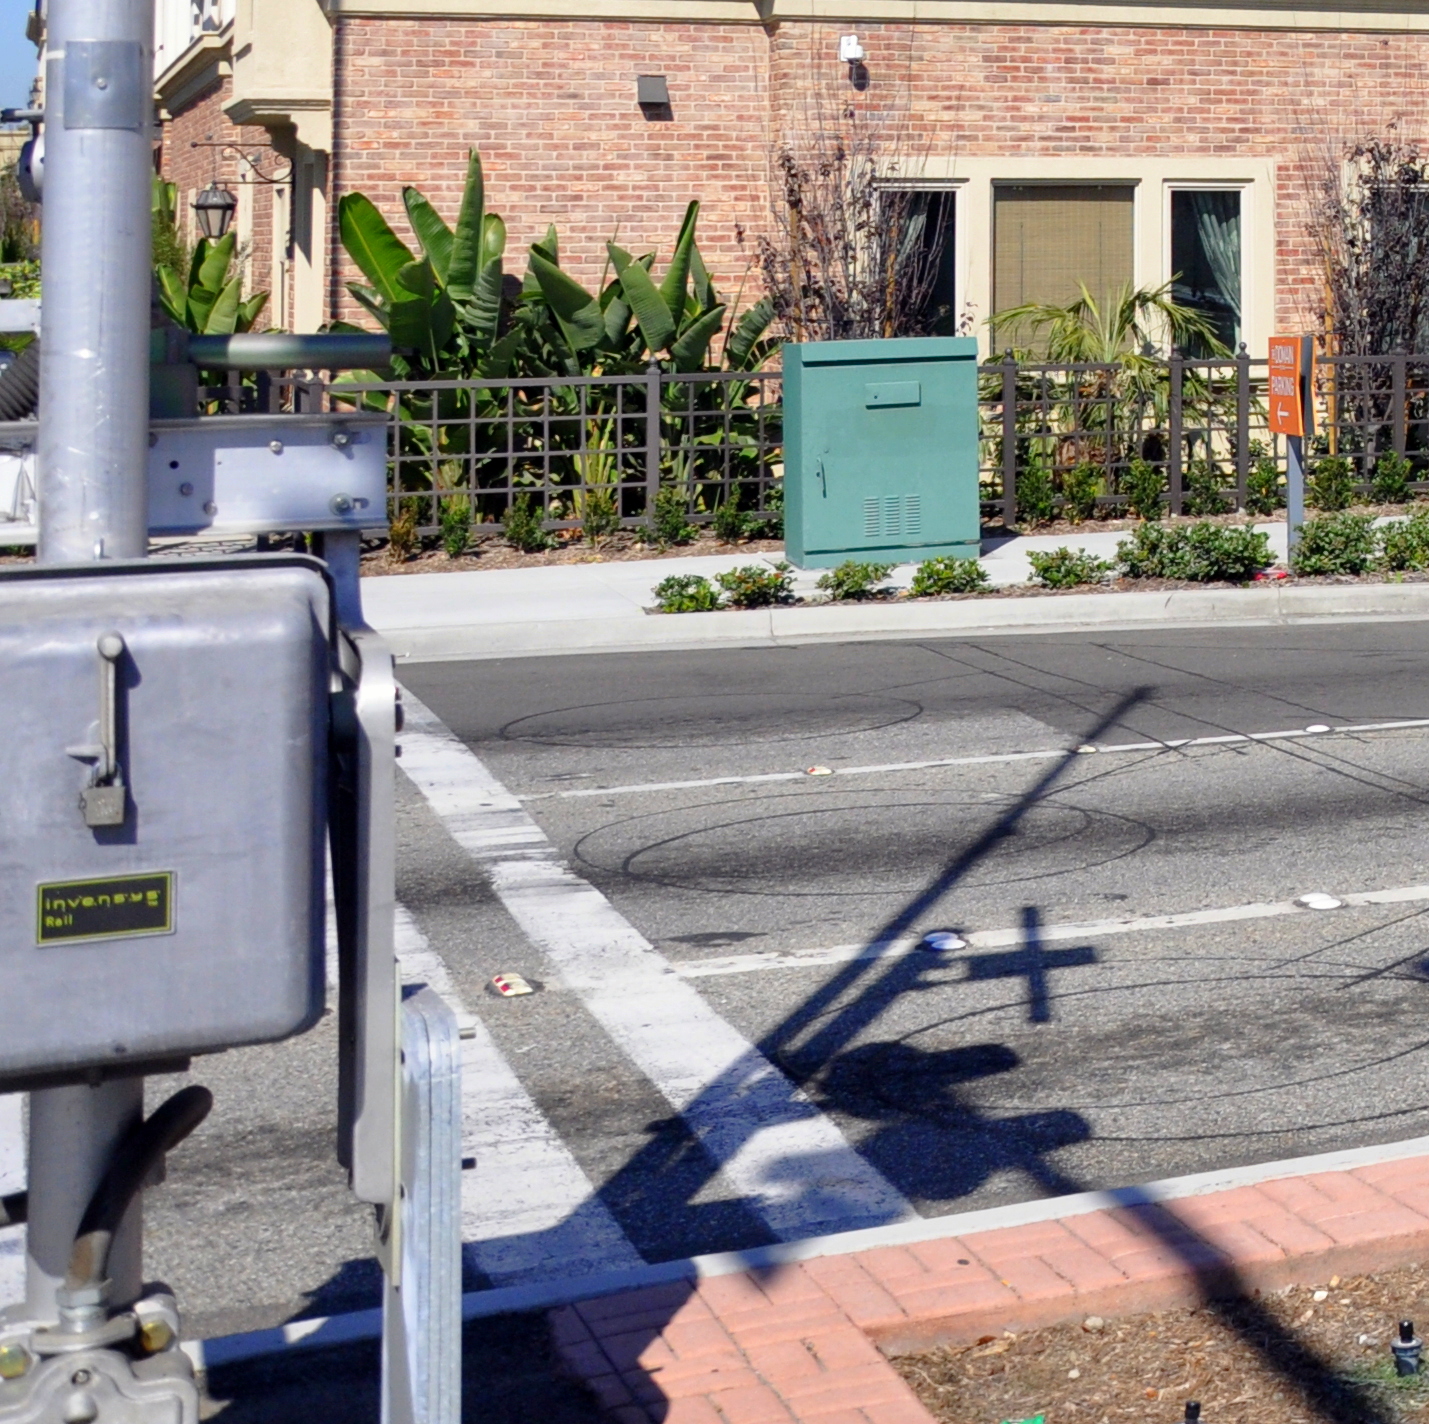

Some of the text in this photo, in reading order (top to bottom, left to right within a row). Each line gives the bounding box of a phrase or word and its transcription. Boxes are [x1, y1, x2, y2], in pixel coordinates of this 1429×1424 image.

[1275, 345, 1294, 364] DOMAIN
[1271, 376, 1294, 396] PARKING
[45, 914, 73, 928] Rail
